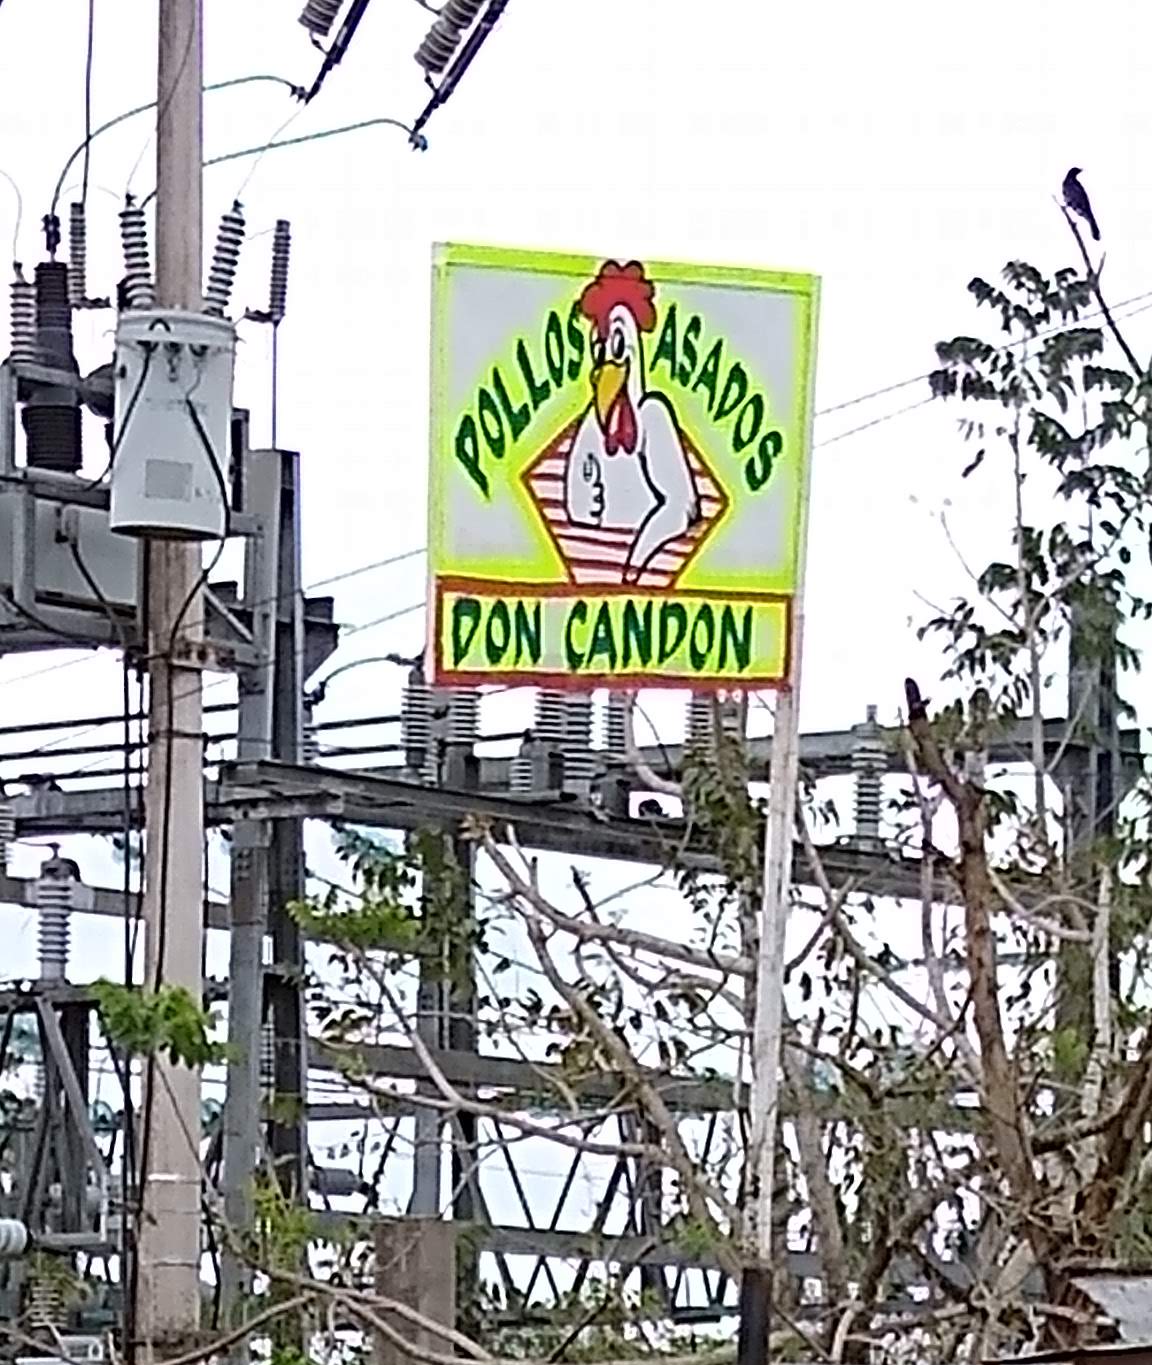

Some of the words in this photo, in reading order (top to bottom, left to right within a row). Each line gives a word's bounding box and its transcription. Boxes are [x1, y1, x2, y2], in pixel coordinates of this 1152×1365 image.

[455, 300, 585, 498] POLLOS
[649, 304, 783, 490] ASADOS
[452, 598, 541, 668] DON
[565, 599, 753, 672] CANDON
